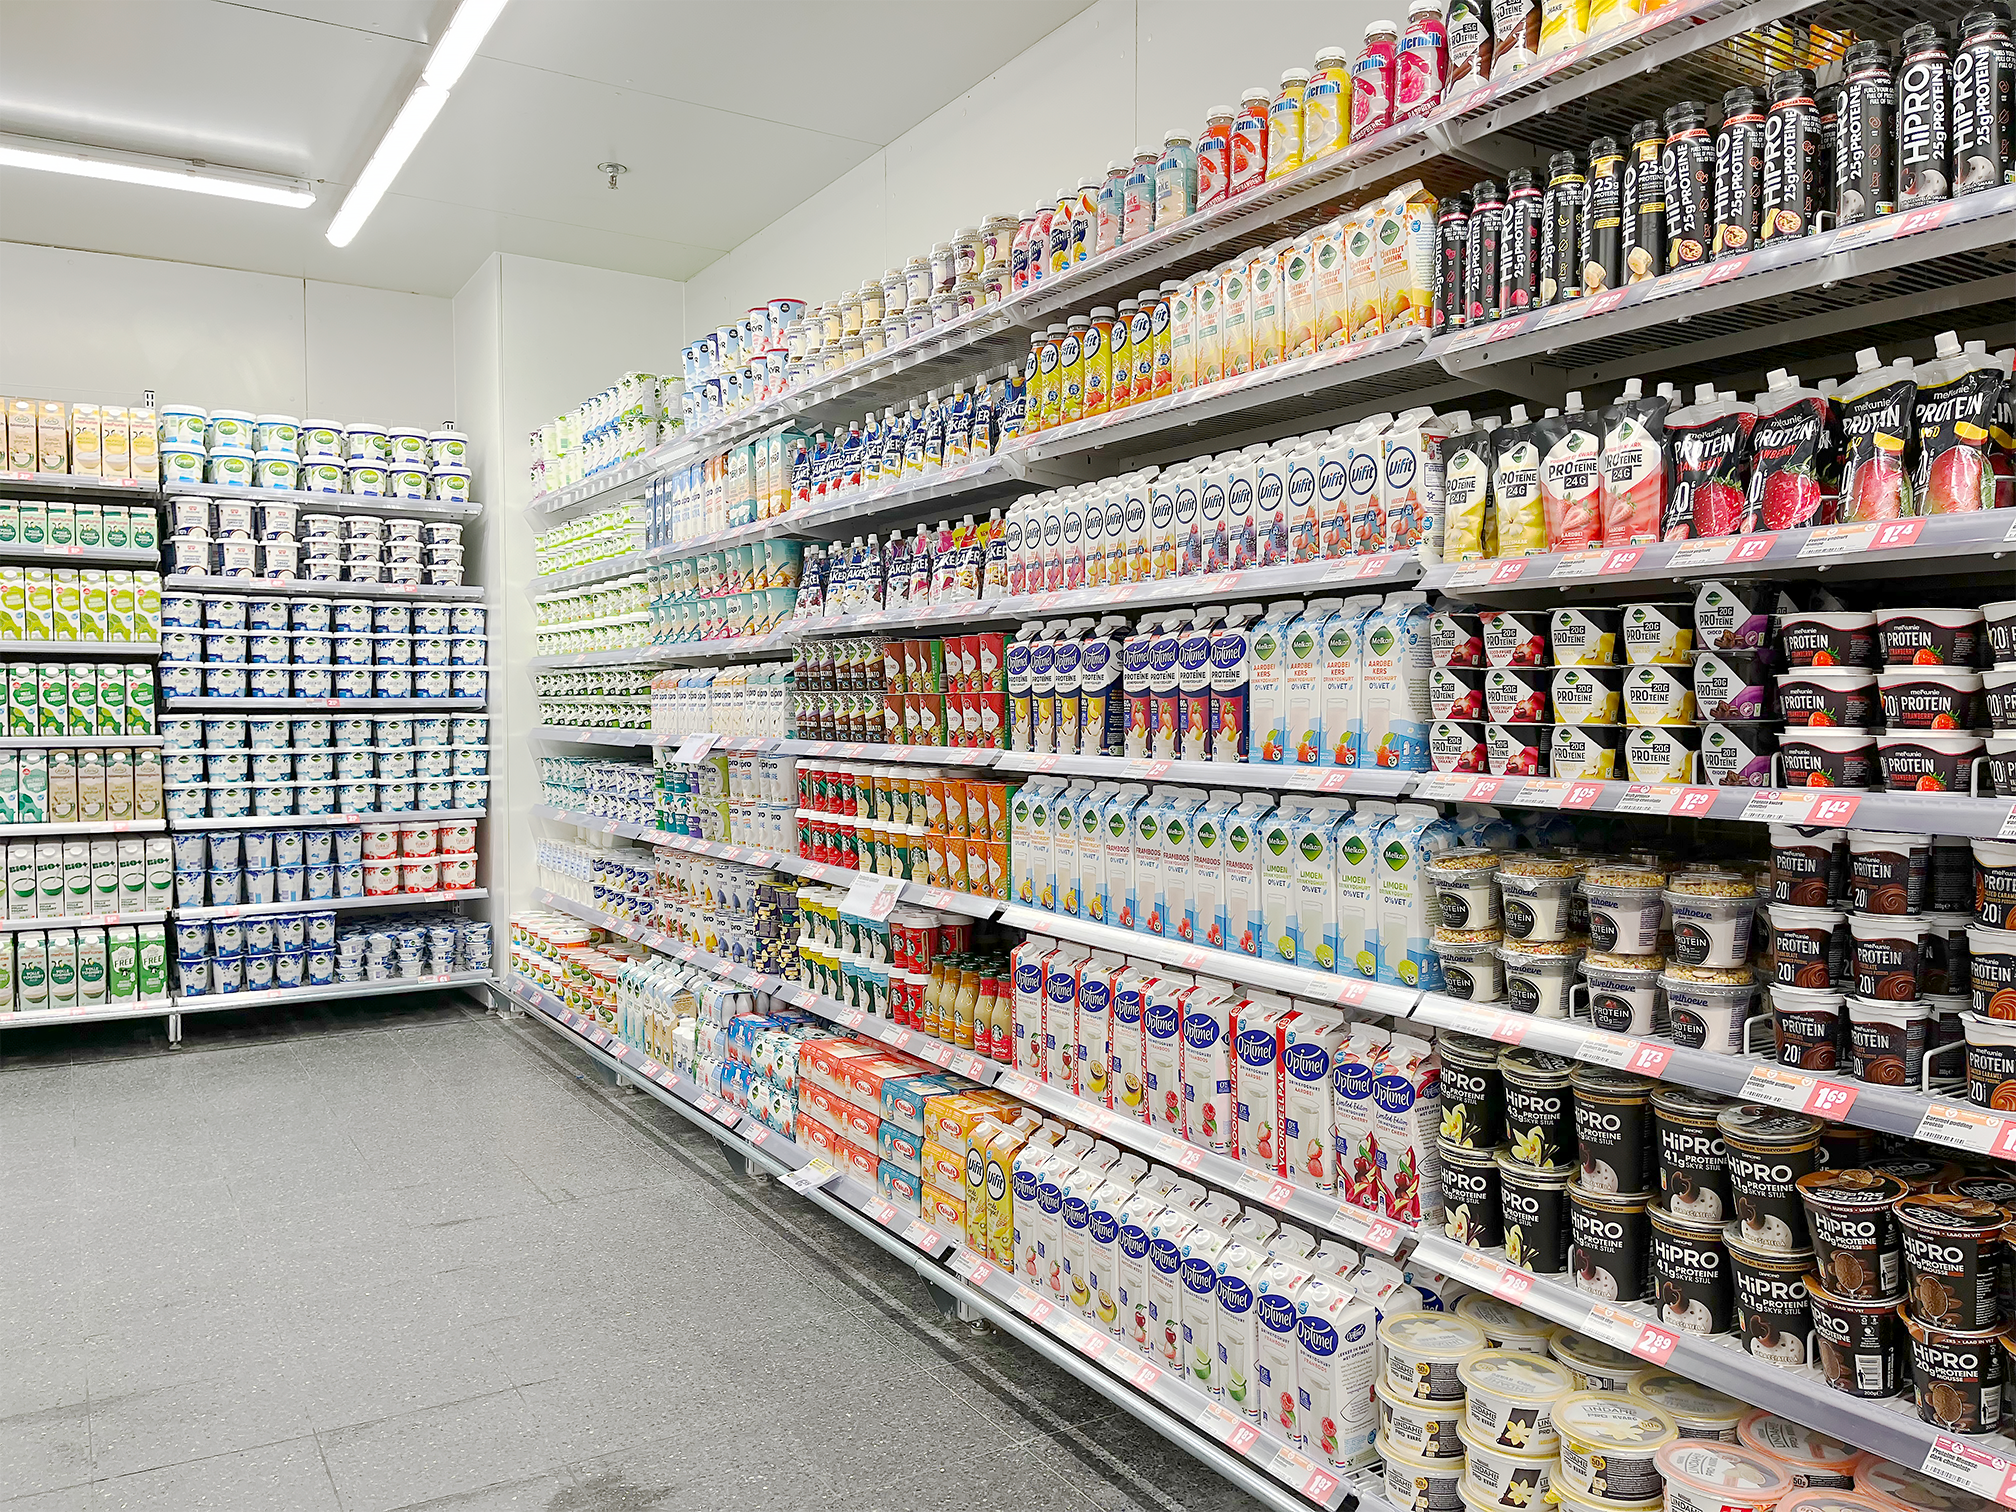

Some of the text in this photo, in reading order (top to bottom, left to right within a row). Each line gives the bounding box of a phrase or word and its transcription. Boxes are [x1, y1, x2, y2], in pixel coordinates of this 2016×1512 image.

[1463, 23, 1477, 32] 35G
[1953, 53, 1972, 156] HiPRO
[1903, 63, 1929, 166] HiPRO
[1763, 115, 1782, 209] HiPRO
[1594, 180, 1619, 191] 25g
[1664, 148, 1679, 238] HiPRO
[1916, 393, 1983, 423] PROTEIN
[1548, 461, 1597, 478] PROTEÏNE
[1612, 468, 1632, 480] 24G
[1564, 476, 1588, 489] 24G
[1450, 493, 1466, 504] 24G
[1507, 486, 1527, 496] 24G
[1442, 630, 1455, 638] 20G
[1502, 629, 1516, 638] 20G
[1570, 626, 1585, 634] 20G
[1644, 622, 1660, 631] 20G
[1789, 635, 1828, 648] PROTEIN
[1888, 632, 1932, 646] PROTEIN
[1211, 641, 1246, 664] Optimel
[1372, 667, 1388, 675] KERS
[1442, 684, 1455, 692] 20G
[1503, 685, 1517, 693] 20G
[1577, 684, 1592, 692] 20G
[1652, 683, 1669, 692] 20G
[1557, 691, 1592, 703] PROTEÏNE
[1631, 691, 1669, 703] PROTEÏNE
[1785, 695, 1825, 709] PROTEIN
[1901, 696, 1951, 711] PROTEIN
[1570, 742, 1585, 751] 20G
[1632, 751, 1670, 762] PROTEÏNE
[1785, 756, 1821, 769] PROTEIN
[1889, 758, 1934, 773] PROTEIN
[1571, 788, 1595, 803] 1.05
[1680, 793, 1708, 811] 1.29
[1818, 799, 1851, 819] 1.42
[1267, 864, 1288, 874] LIMOEN
[1777, 858, 1816, 873] PROTEIN
[1854, 863, 1891, 879] PROTEIN
[1300, 870, 1324, 881] LIMOEN
[1342, 874, 1366, 885] LIMOEN
[1383, 881, 1408, 891] LIMOEN
[1777, 938, 1819, 954] PROTEIN
[114, 958, 133, 967] FREE
[143, 955, 162, 965] FREE
[1858, 948, 1902, 965] PROTEIN
[1145, 1010, 1179, 1036] Optimel
[1183, 1017, 1219, 1043] Optimel
[1782, 1020, 1825, 1037] PROTEIN
[1236, 1035, 1275, 1065] Optimel
[1284, 1049, 1329, 1079] Optimel
[1333, 1069, 1372, 1096] Optimel
[1372, 1082, 1414, 1110] Optimel
[1505, 1086, 1560, 1112] HiPRO
[1818, 1087, 1847, 1110] 1.69
[1277, 1071, 1285, 1166] VOORDEELPAK
[1584, 1130, 1621, 1140] PROTEINE
[1662, 1129, 1728, 1155] HiPRO
[1663, 1149, 1685, 1168] 41g
[1685, 1155, 1727, 1164] PROTEINE
[1727, 1153, 1793, 1182] HiPRO
[1440, 1165, 1486, 1191] HiPRO
[1731, 1174, 1749, 1194] 41g
[1747, 1180, 1794, 1192] PROTEINE
[1089, 1214, 1118, 1242] Optimel
[1571, 1213, 1623, 1239] HiPRO
[1815, 1211, 1876, 1236] HiPRO
[1584, 1237, 1623, 1248] PROTEINE
[1818, 1227, 1836, 1245] 20g
[1835, 1235, 1877, 1245] PROTEINE
[1150, 1242, 1181, 1271] Optimel
[1656, 1241, 1719, 1269] HiPRO
[1902, 1237, 1964, 1262] HiPRO
[1657, 1259, 1675, 1278] 41g
[1675, 1266, 1719, 1278] PROTEINE
[1921, 1260, 1965, 1273] PROTEINE
[1181, 1261, 1214, 1290] Optimel
[1217, 1279, 1252, 1310] Optimel
[1738, 1274, 1808, 1300] HiPRO
[1741, 1293, 1763, 1312] 41g
[1763, 1298, 1808, 1309] PROTEINE
[1259, 1298, 1296, 1329] Optimel
[1296, 1321, 1337, 1353] Optimel
[1642, 1331, 1672, 1354] 2.89
[1914, 1343, 1979, 1369] HiPRO
[1916, 1360, 1936, 1377] 20g
